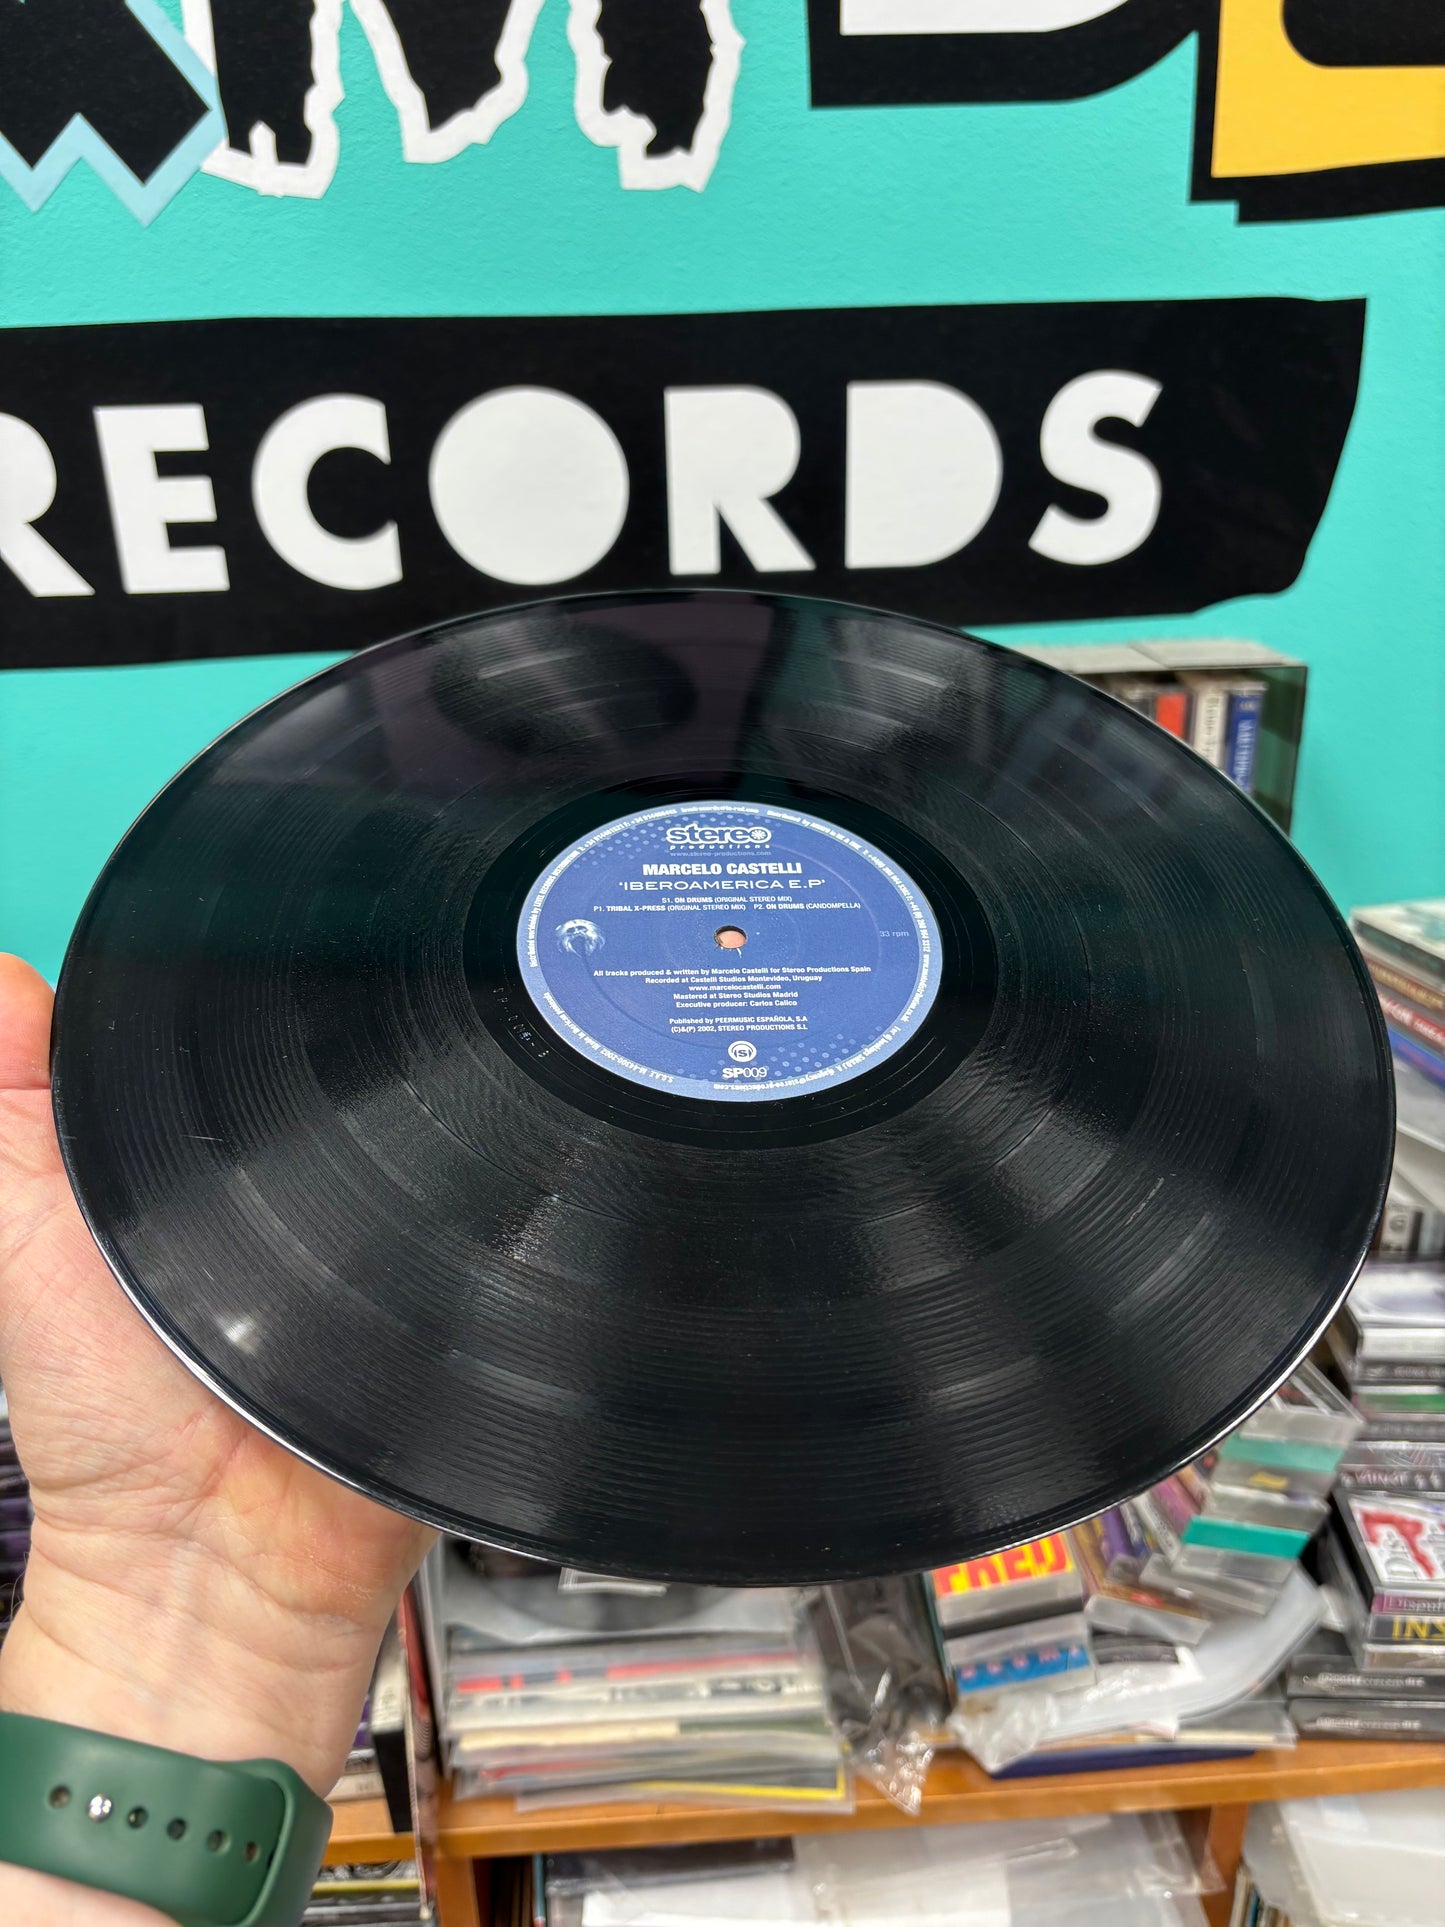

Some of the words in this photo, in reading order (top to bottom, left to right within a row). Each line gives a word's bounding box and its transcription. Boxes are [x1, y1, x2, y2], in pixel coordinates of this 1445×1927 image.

[0, 370, 1163, 597] RECORDS
[666, 824, 772, 844] stereo
[643, 864, 722, 875] MARCELO
[727, 863, 802, 874] CASTELLI
[722, 1067, 767, 1078] SP009
